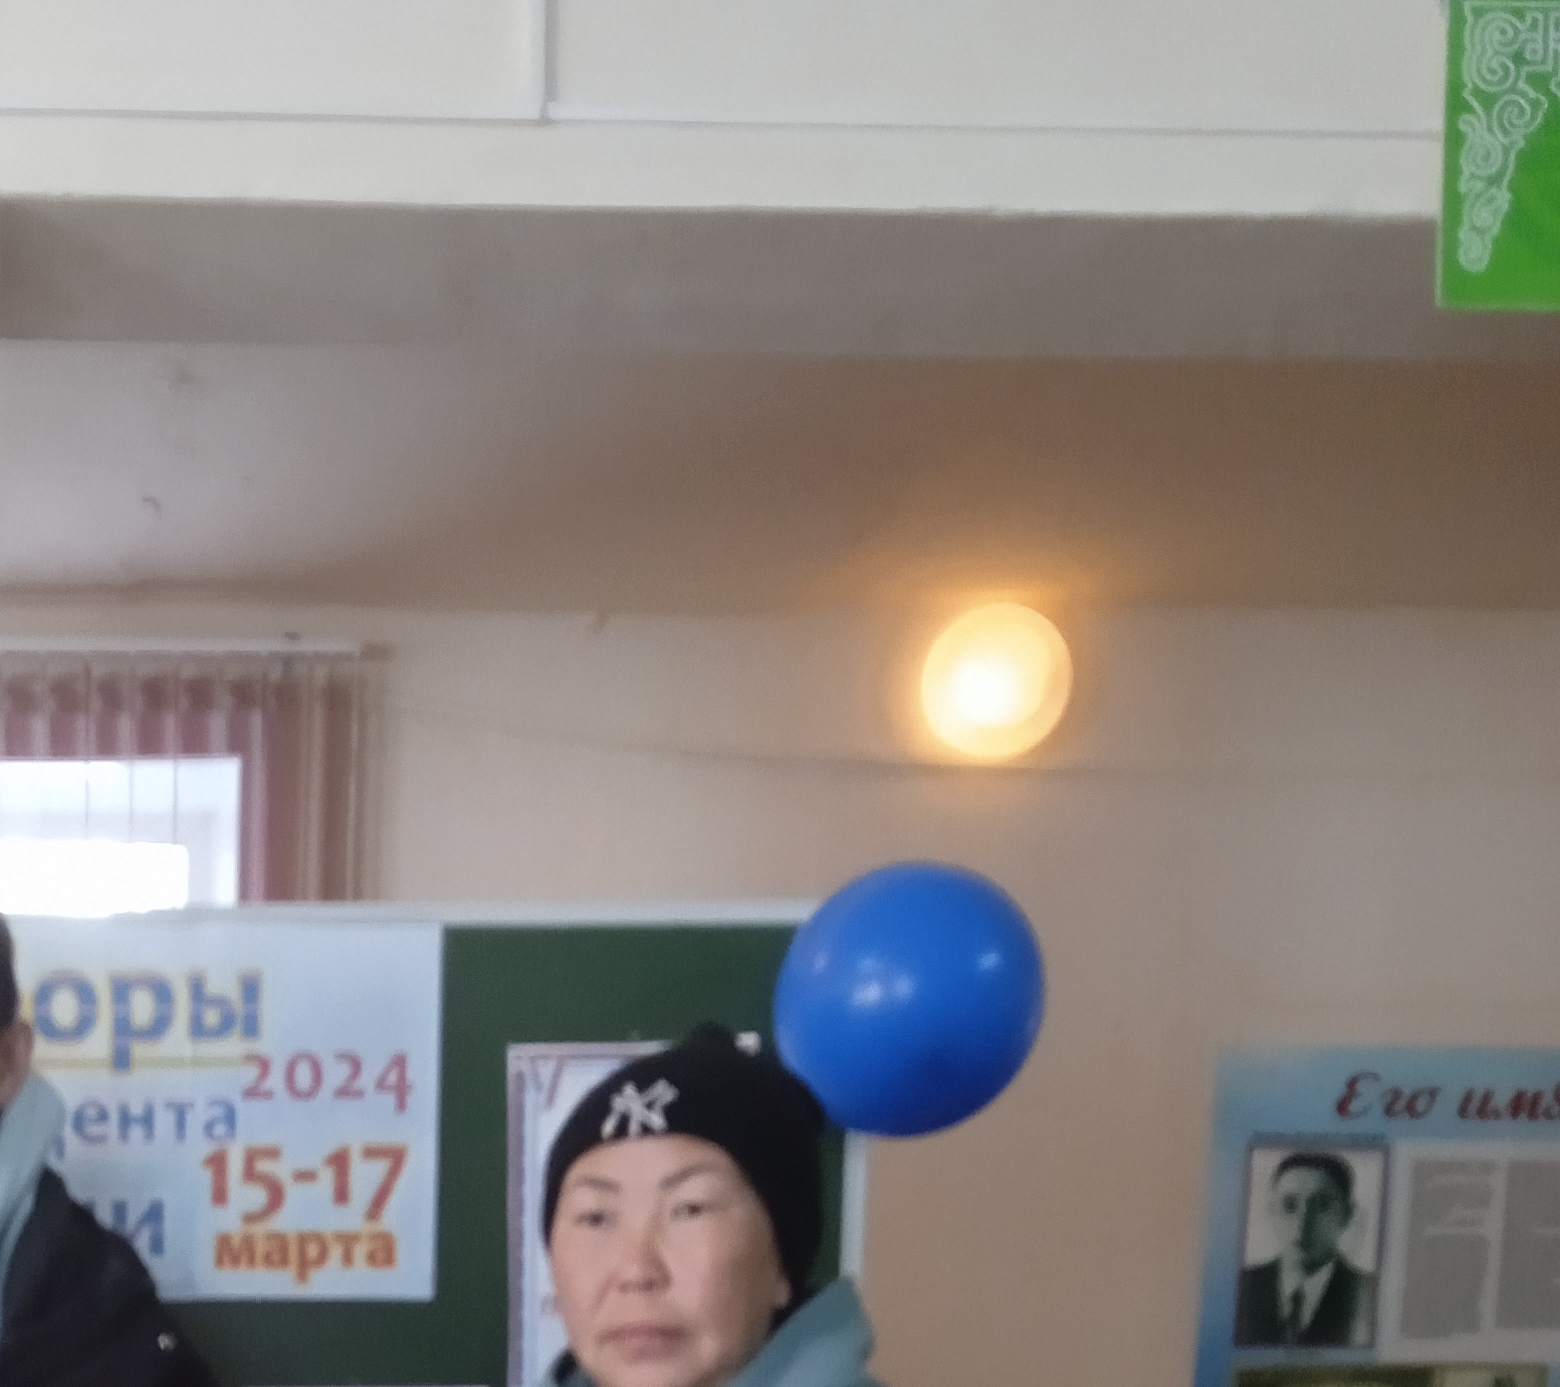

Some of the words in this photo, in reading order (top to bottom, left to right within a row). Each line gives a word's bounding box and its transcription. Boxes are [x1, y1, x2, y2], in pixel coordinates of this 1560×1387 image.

[30, 966, 263, 1073] оры
[241, 1050, 412, 1114] 2024
[1336, 1070, 1441, 1120] Его
[203, 1143, 409, 1226] 15-17
[213, 1231, 397, 1286] марта
